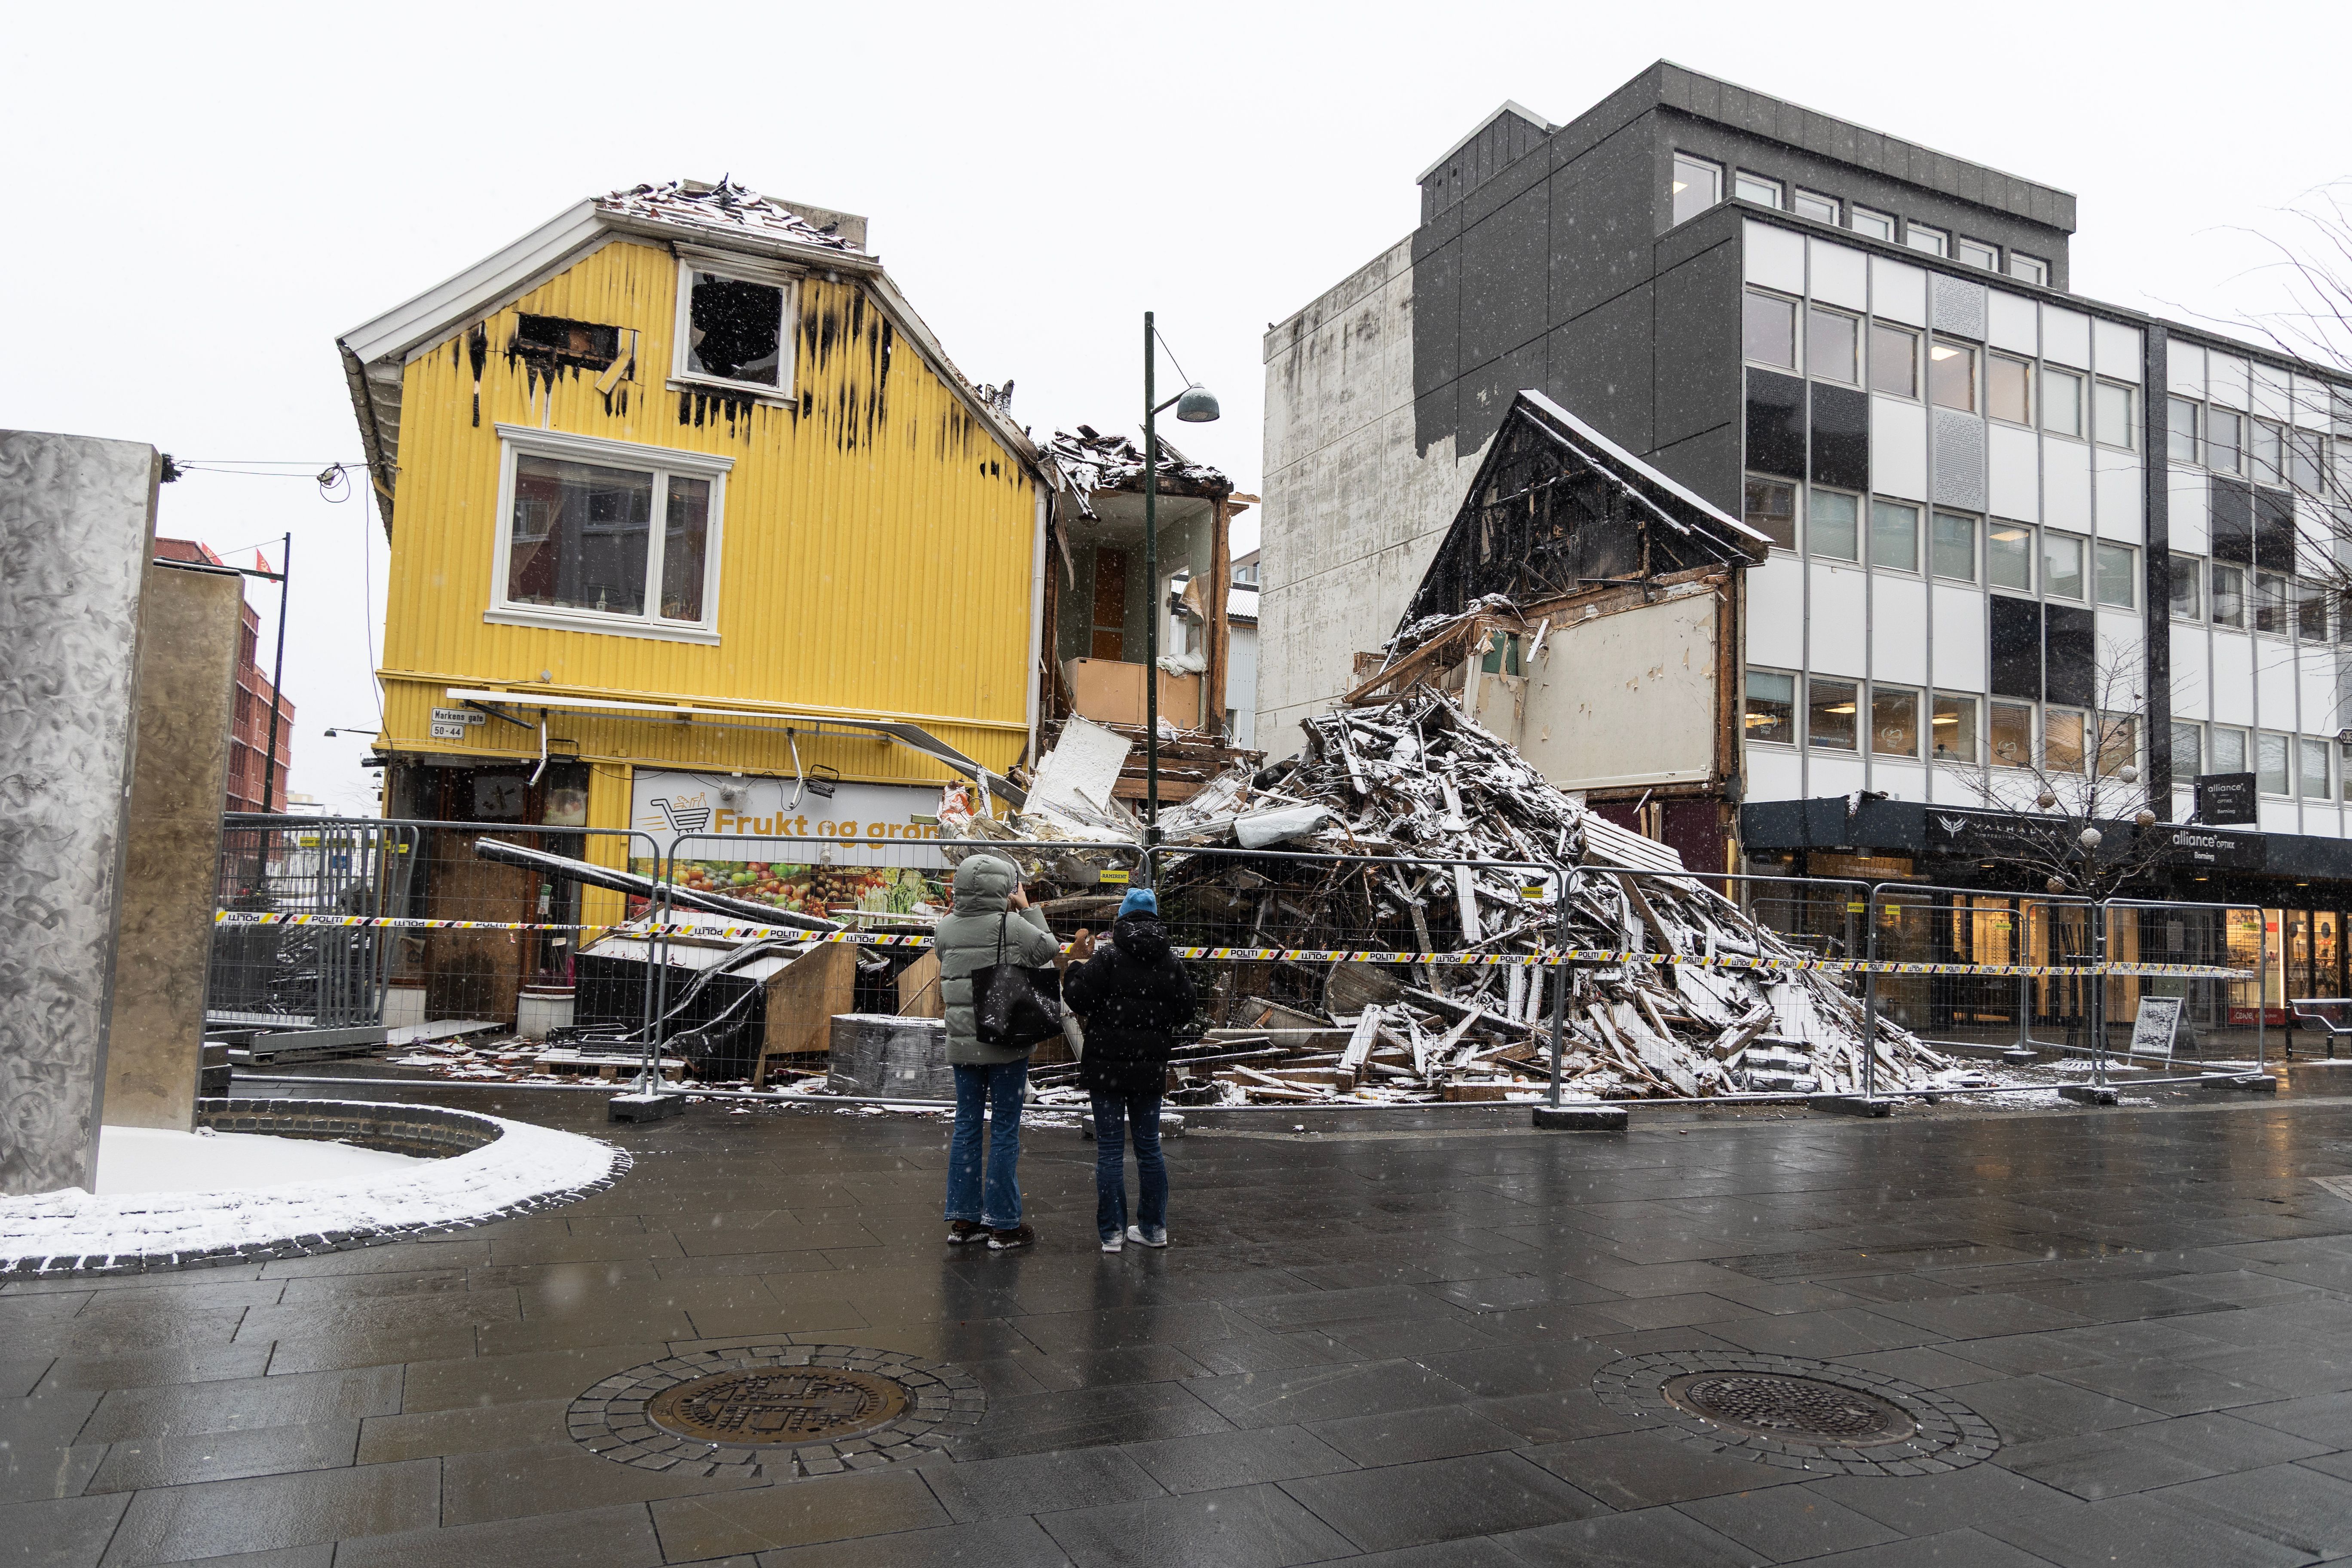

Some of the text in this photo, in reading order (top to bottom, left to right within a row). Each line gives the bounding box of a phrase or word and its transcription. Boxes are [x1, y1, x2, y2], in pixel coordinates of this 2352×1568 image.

[435, 710, 483, 723] Markens gate
[1809, 735, 1851, 743] www.mercyships.no
[714, 808, 808, 836] Frukt
[818, 820, 858, 848] og
[2216, 841, 2235, 849] OPTIKK
[228, 914, 260, 922] POLITI
[312, 916, 343, 924] POLITI
[770, 930, 799, 938] POLITI
